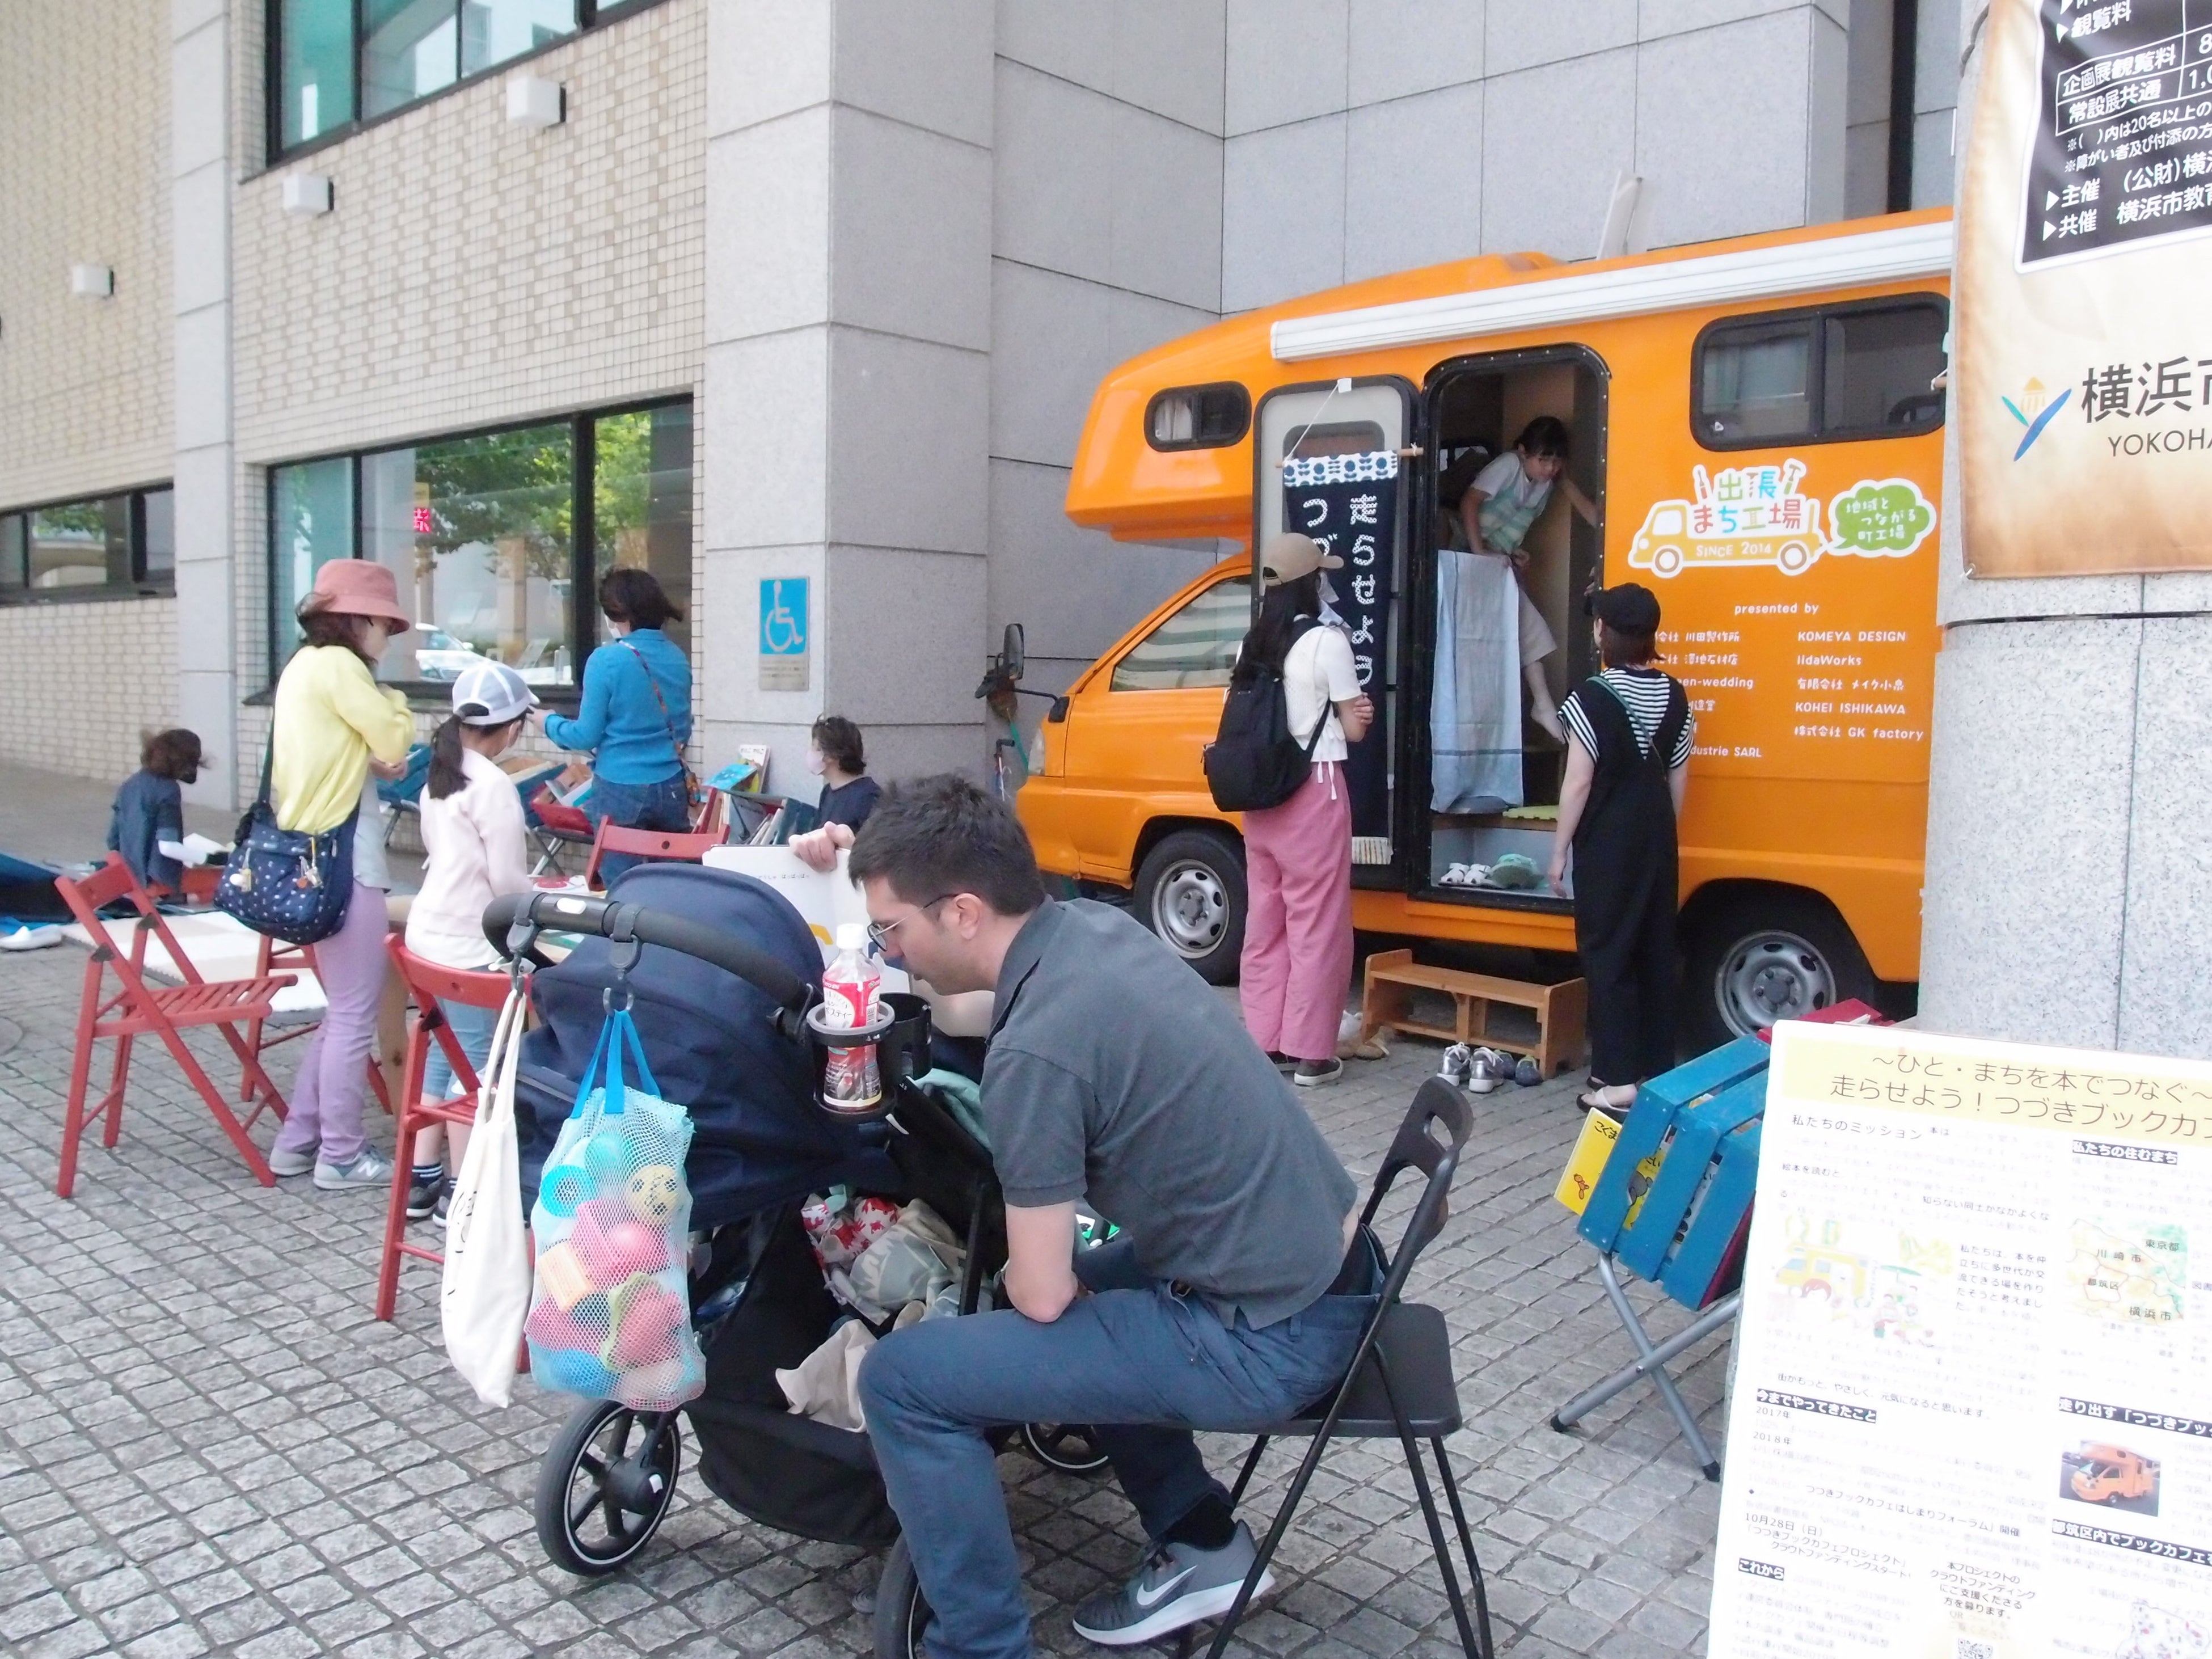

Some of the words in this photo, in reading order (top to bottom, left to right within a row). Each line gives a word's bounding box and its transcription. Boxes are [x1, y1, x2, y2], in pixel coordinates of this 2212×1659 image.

[2071, 1, 2131, 38] 観覧料
[2062, 44, 2176, 97] 企画展観覧料
[2069, 79, 2162, 124] 常設展共通
[2124, 150, 2212, 193] (公財)横
[2061, 177, 2100, 208] 主催
[2058, 208, 2097, 239] 共催
[1694, 498, 1802, 534] まち工場
[1861, 508, 1916, 526] つながる
[1858, 524, 1905, 543] 町工場
[1696, 544, 1733, 558] SINCE
[1741, 541, 1772, 555] 2014
[1734, 602, 1798, 616] presented
[1804, 602, 1820, 615] by
[1655, 631, 1679, 642] 会社
[1797, 631, 1851, 642] KOMEYA
[1858, 631, 1906, 642] DESIGN
[1676, 676, 1754, 689] en-wedding
[1797, 677, 1843, 690] 有限会社
[1795, 702, 1833, 713] KOHEI
[1839, 702, 1906, 715] ISHIKAWA
[1794, 725, 1841, 737] 株式会社
[1848, 727, 1865, 737] GK
[1873, 728, 1924, 742] factory
[1691, 745, 1729, 757] dustrie
[1734, 746, 1762, 758] SARL
[1792, 1115, 1923, 1141] 私たちのミッション
[2072, 1141, 2178, 1164] 私たちの住むまち
[357, 1162, 380, 1177] N
[2145, 1238, 2180, 1252] 東京都
[2087, 1277, 2120, 1291] 都筑区
[2129, 1306, 2172, 1322] 横浜市
[1755, 1405, 1791, 1420] 2017年
[1757, 1390, 1876, 1423] 今までやってきたこと
[2058, 1398, 2212, 1437] 走り出す「つづきブッ
[1753, 1431, 1793, 1446] 2018年
[1745, 1512, 1795, 1531] 10月28日
[1738, 1558, 1785, 1581] これから
